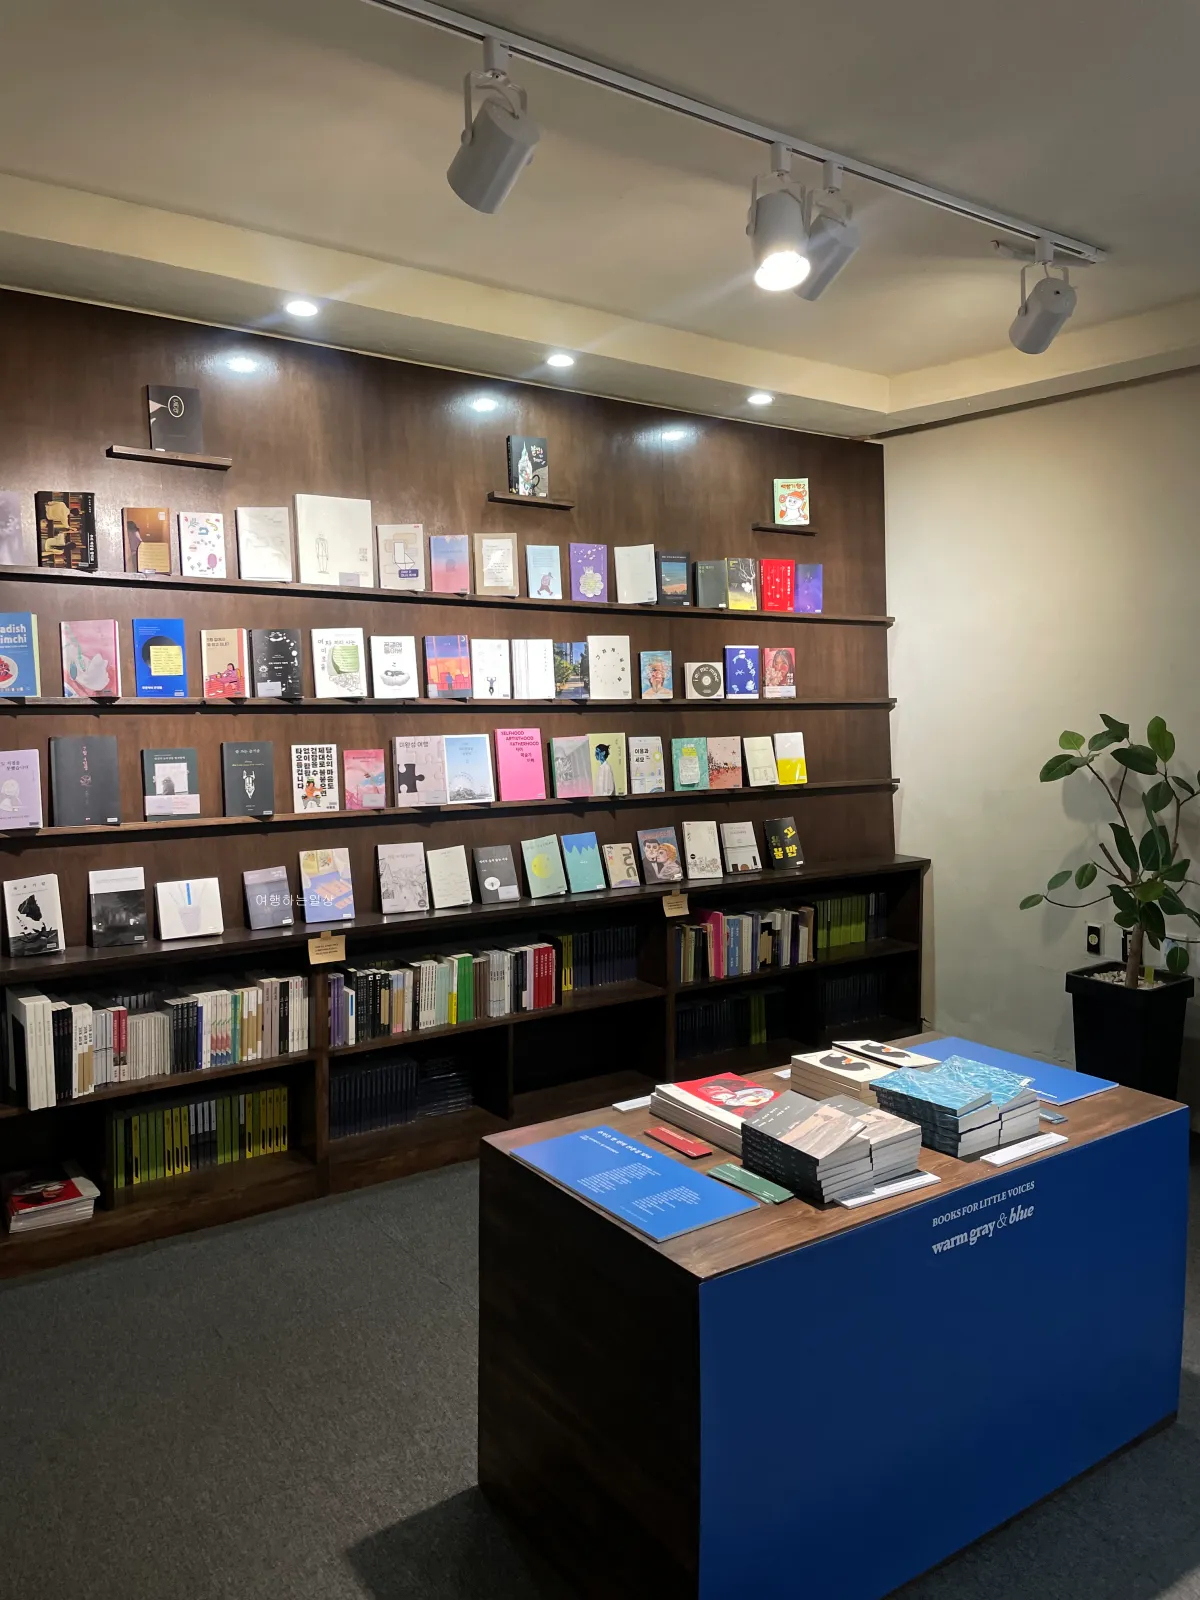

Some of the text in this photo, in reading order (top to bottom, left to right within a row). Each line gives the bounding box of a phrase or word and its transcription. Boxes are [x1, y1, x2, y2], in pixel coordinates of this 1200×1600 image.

[0, 624, 27, 633] adish
[0, 634, 27, 644] imchi
[932, 1180, 1035, 1228] BOOKS FOR LITTLE VOICES
[932, 1204, 1035, 1256] warm gray & blue
